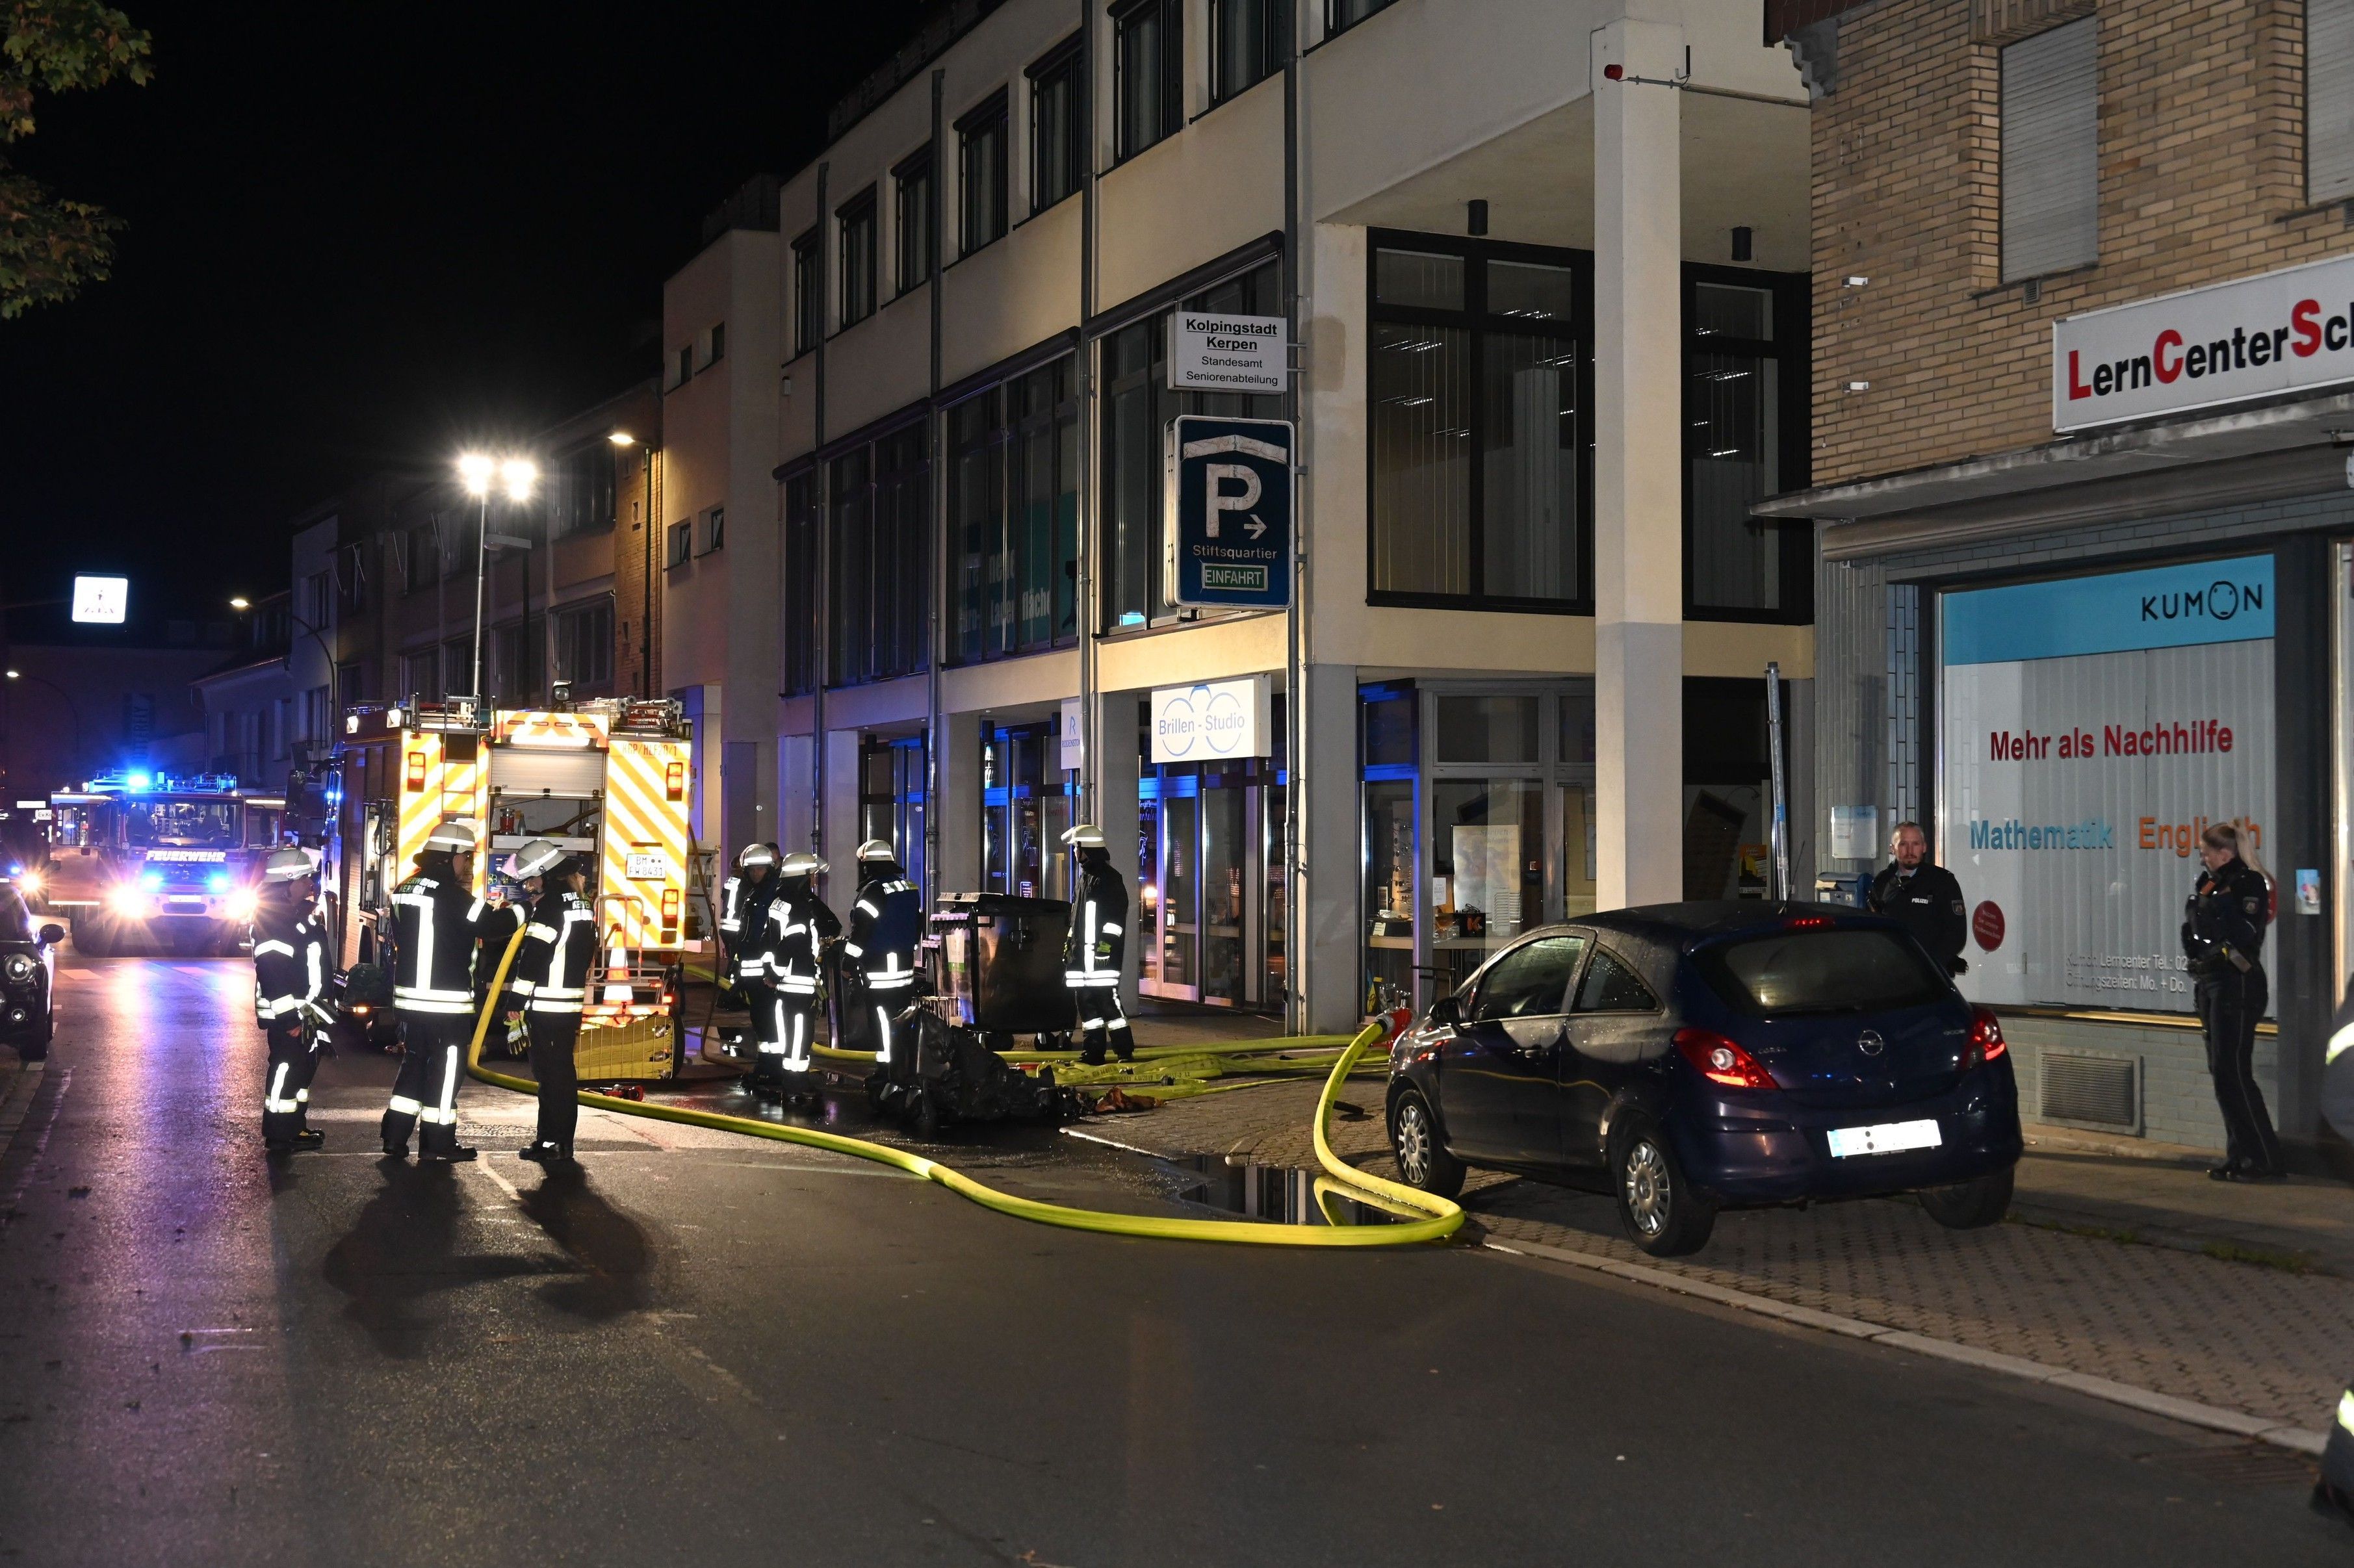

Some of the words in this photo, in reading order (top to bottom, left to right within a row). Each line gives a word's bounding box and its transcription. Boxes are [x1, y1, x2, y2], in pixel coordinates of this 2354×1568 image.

[1186, 319, 1277, 337] Kolpingstadt
[1207, 337, 1257, 352] Kerpen
[2069, 299, 2354, 400] LernCenterSc
[1202, 356, 1262, 368] Standesamt
[1186, 371, 1278, 387] Seniorenabteilung
[1206, 463, 1261, 538] P
[1193, 545, 1277, 559] Stiftsquartier
[1204, 570, 1261, 585] EINFAHRT
[2142, 580, 2263, 622] KUMON
[1159, 718, 1195, 735] Brillen
[1206, 712, 1245, 730] Studio
[1061, 738, 1080, 747] RODENSTO
[1990, 730, 2051, 761] Mehr
[2058, 727, 2094, 759] als
[2104, 719, 2234, 757] Nachhilfe
[1971, 816, 2113, 849] Mathematik
[2138, 816, 2260, 858] Englih
[146, 850, 226, 862] FEUERWEHR
[2100, 953, 2151, 970] Lerncenter
[2140, 975, 2158, 992] Mo.
[2171, 976, 2186, 993] Do.
